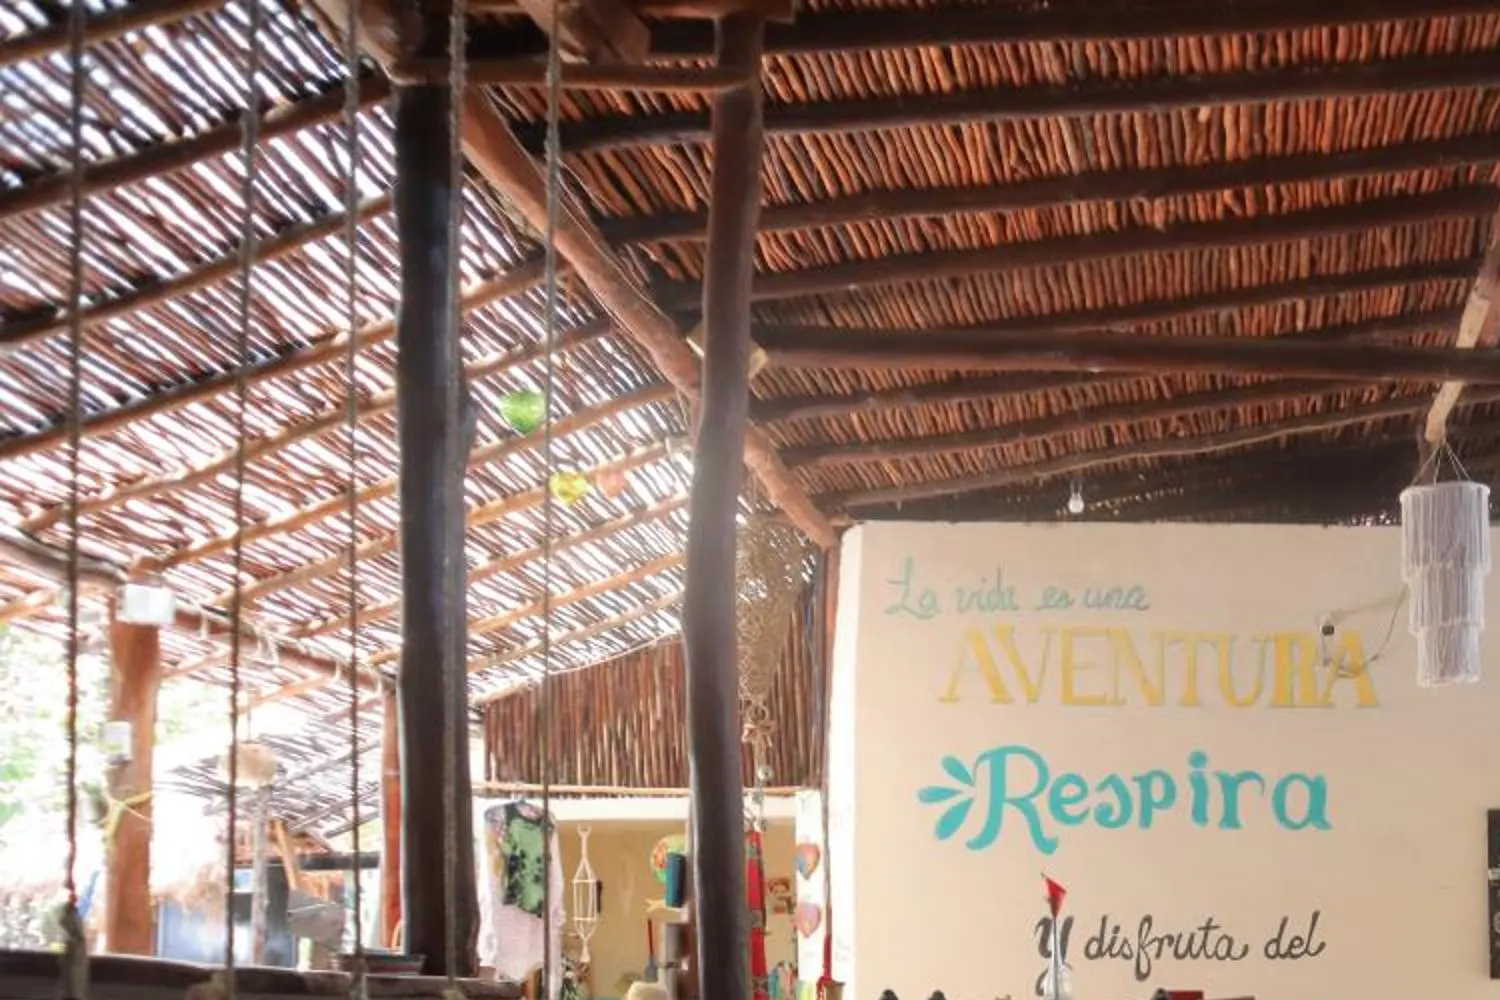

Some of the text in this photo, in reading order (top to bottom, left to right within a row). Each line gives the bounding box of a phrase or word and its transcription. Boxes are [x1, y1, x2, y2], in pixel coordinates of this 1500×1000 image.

[884, 555, 1150, 620] La vida es una
[937, 622, 1382, 709] AVENTURA
[965, 744, 1334, 856] Respira
[1083, 913, 1249, 982] disfruta
[1263, 909, 1327, 960] del
